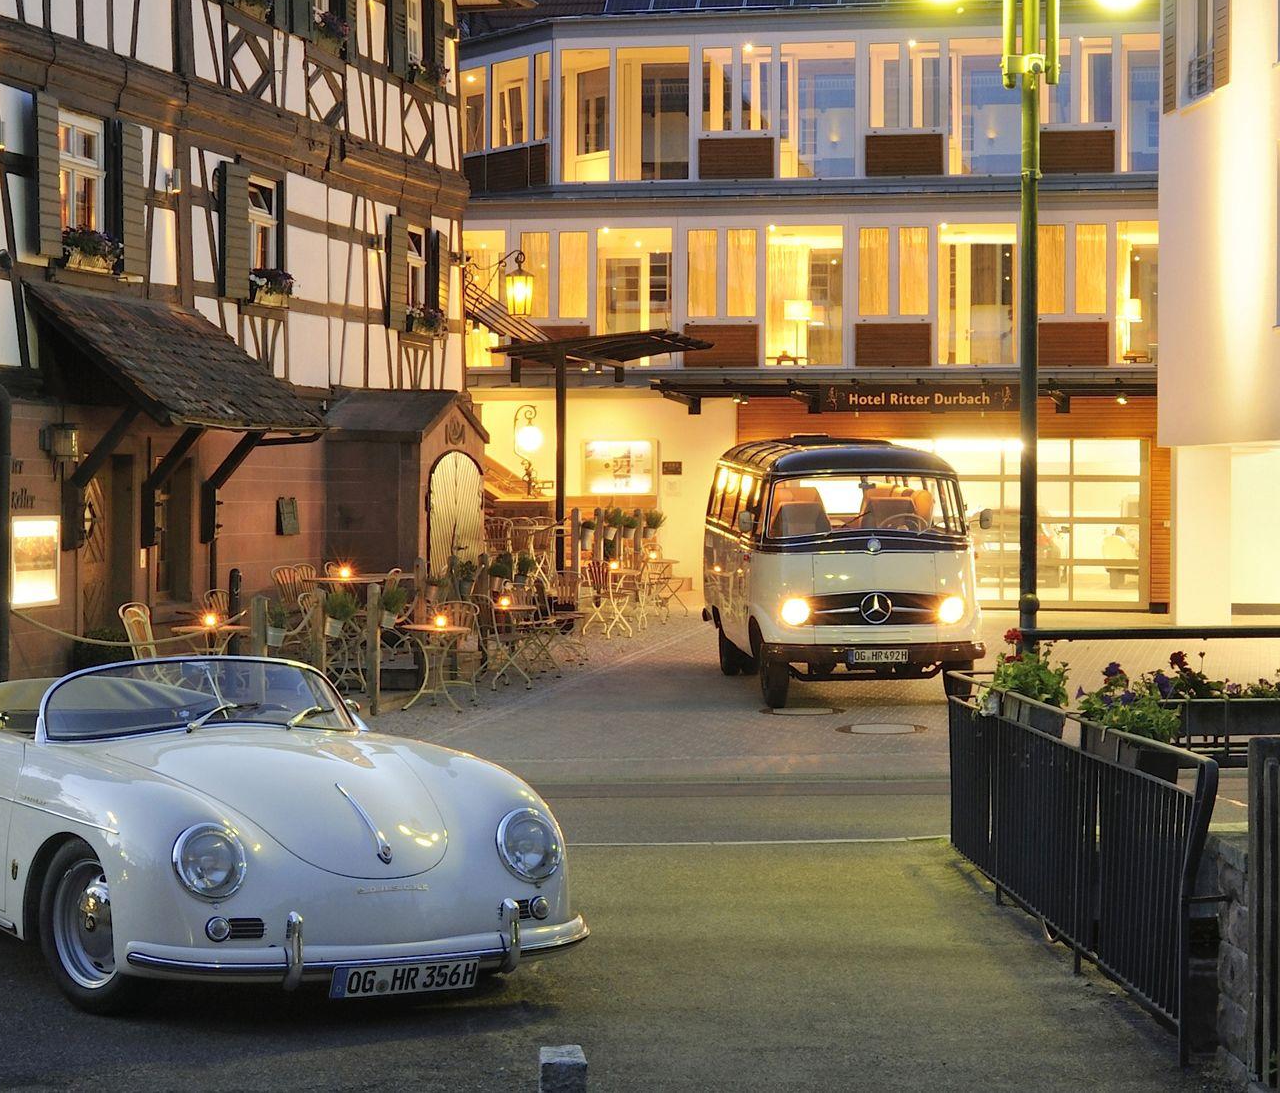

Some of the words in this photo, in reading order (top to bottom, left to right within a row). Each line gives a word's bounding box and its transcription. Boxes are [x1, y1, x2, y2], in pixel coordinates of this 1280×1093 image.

[849, 393, 885, 405] Hotel
[890, 393, 930, 405] Ritter
[934, 392, 990, 405] Durbach
[854, 651, 866, 661] OG
[347, 970, 376, 994] OG
[391, 967, 419, 991] HR
[422, 962, 477, 988] 356H
